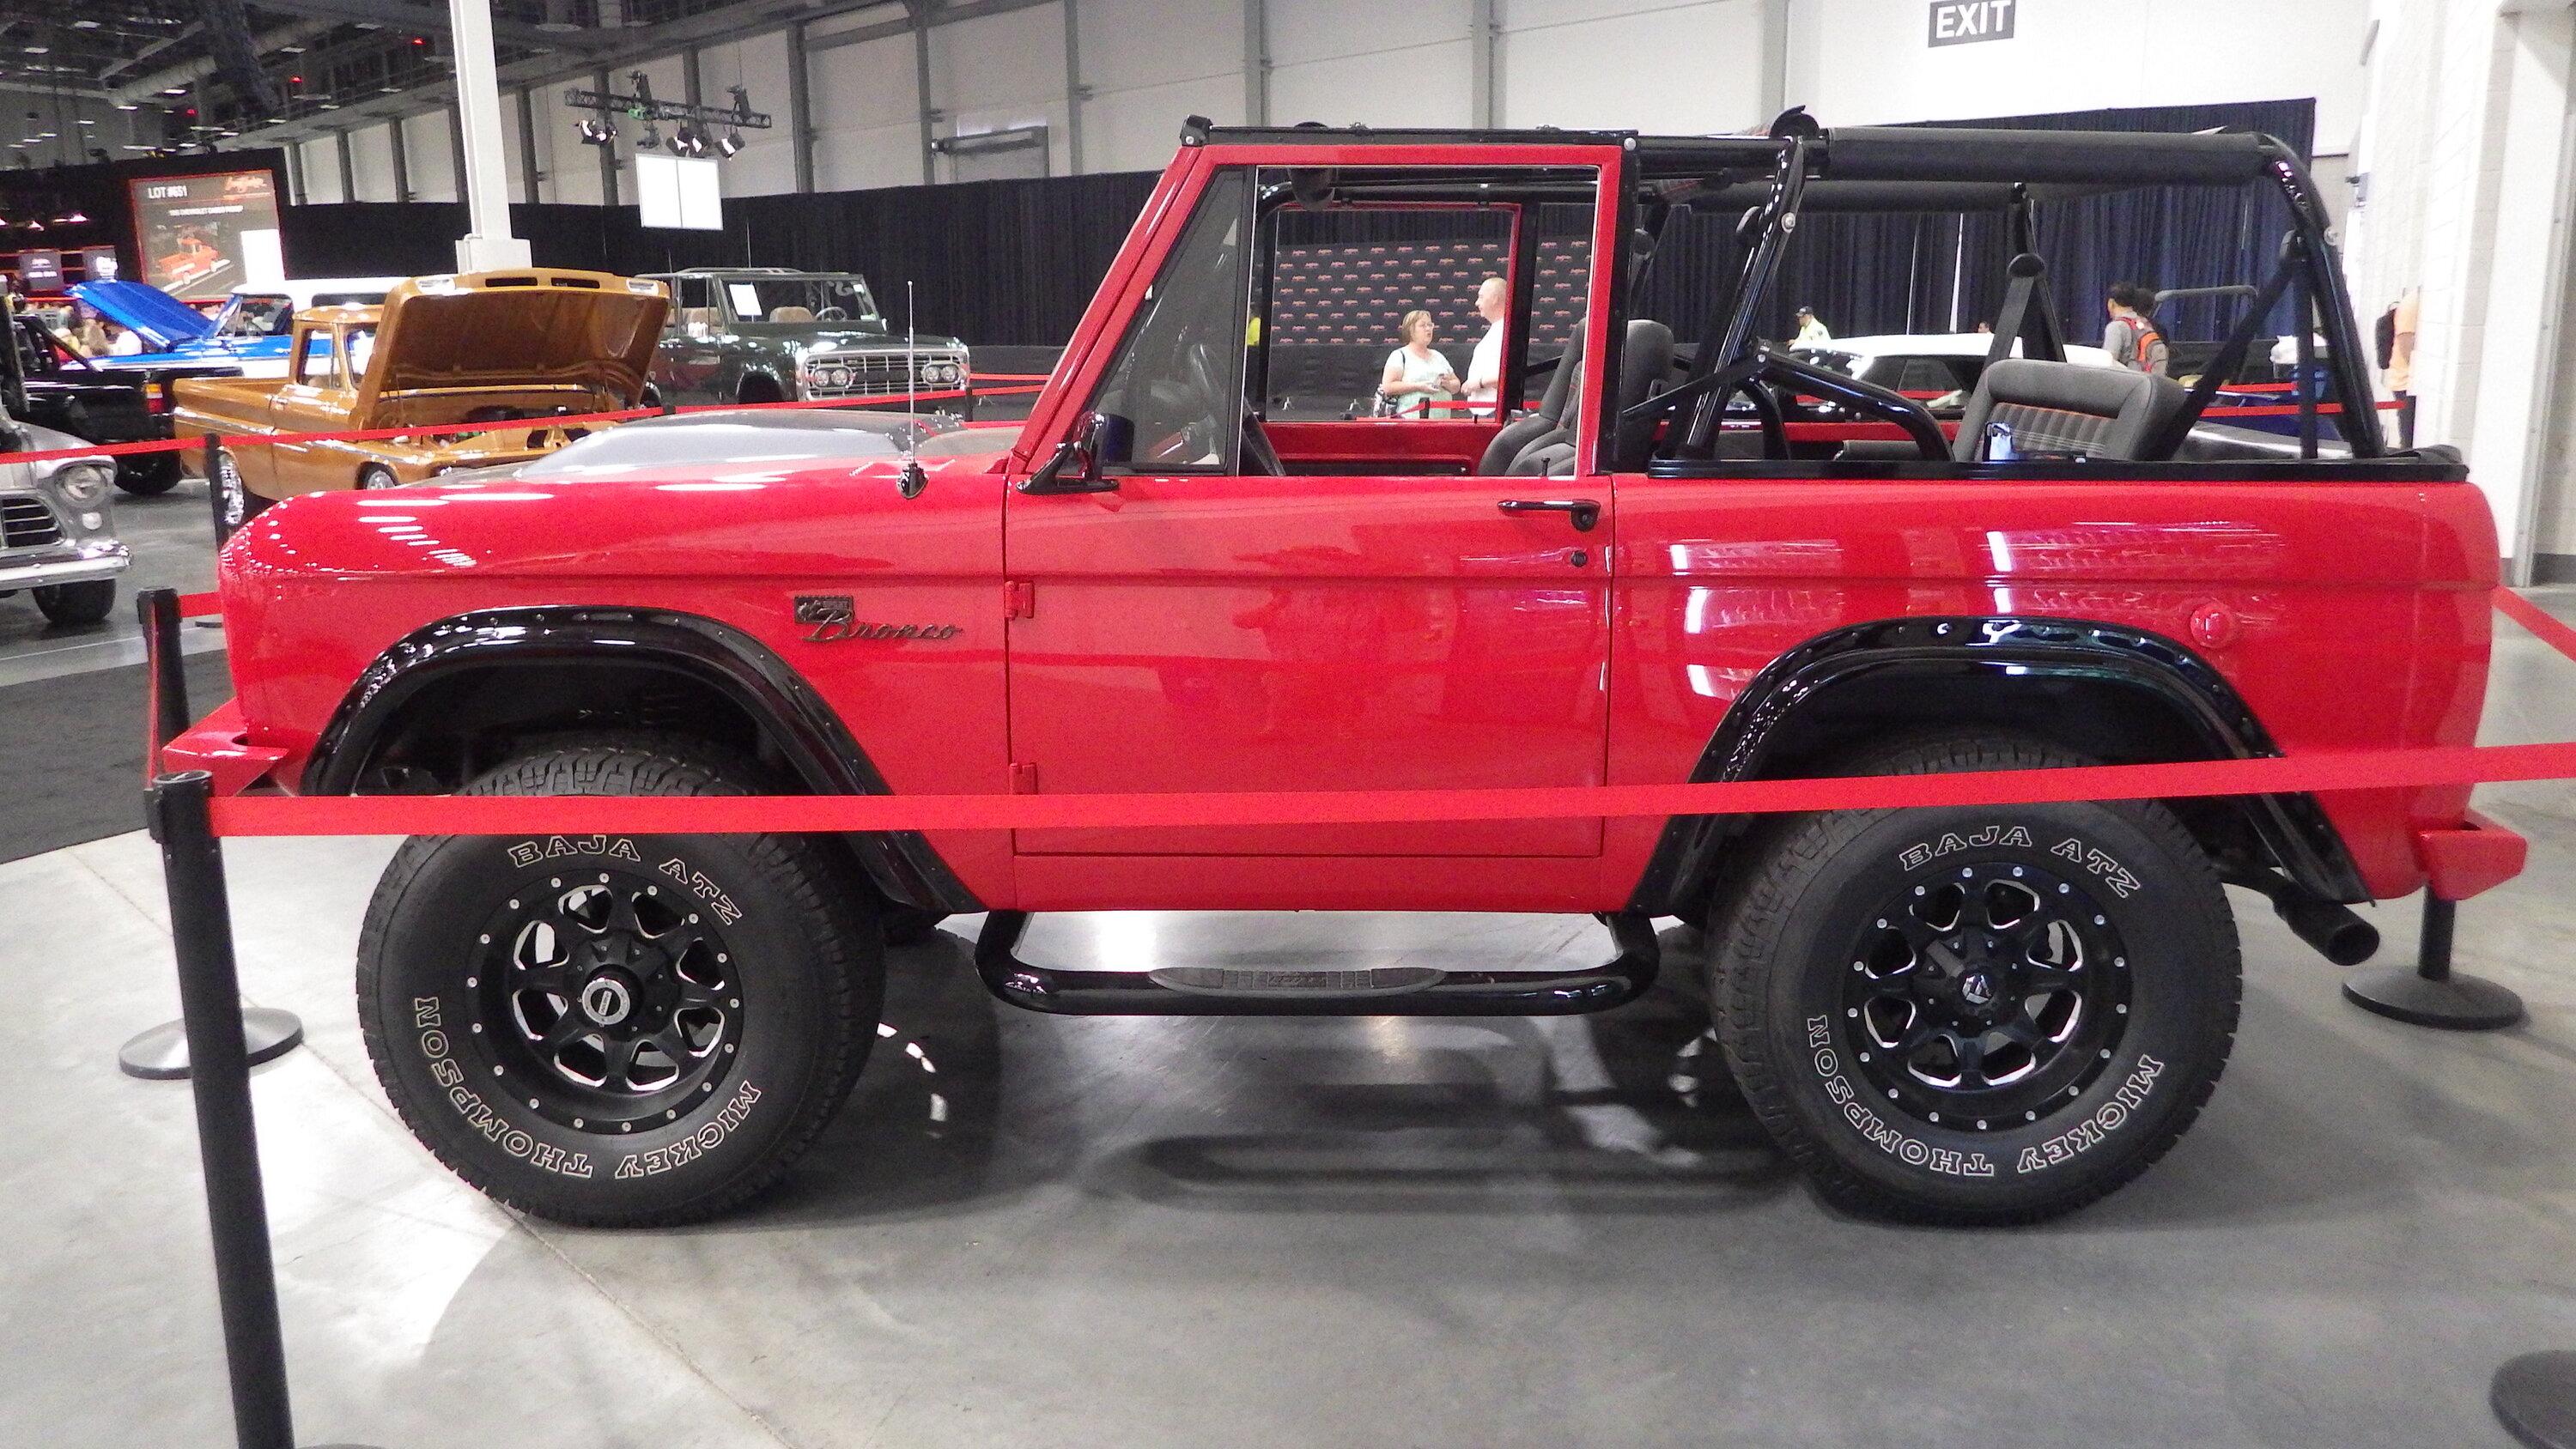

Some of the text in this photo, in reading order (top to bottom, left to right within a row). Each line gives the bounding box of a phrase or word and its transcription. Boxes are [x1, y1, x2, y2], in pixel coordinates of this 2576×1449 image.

[1935, 0, 2013, 39] EXIT
[147, 185, 167, 199] LOT
[800, 607, 964, 643] Bronco
[507, 834, 743, 925] BAJA ATZ
[1899, 825, 2142, 899] BAJA ATZ
[415, 997, 762, 1179] MICKEY THOMPSON
[1807, 1014, 2165, 1177] MICKEY THOMPSON
